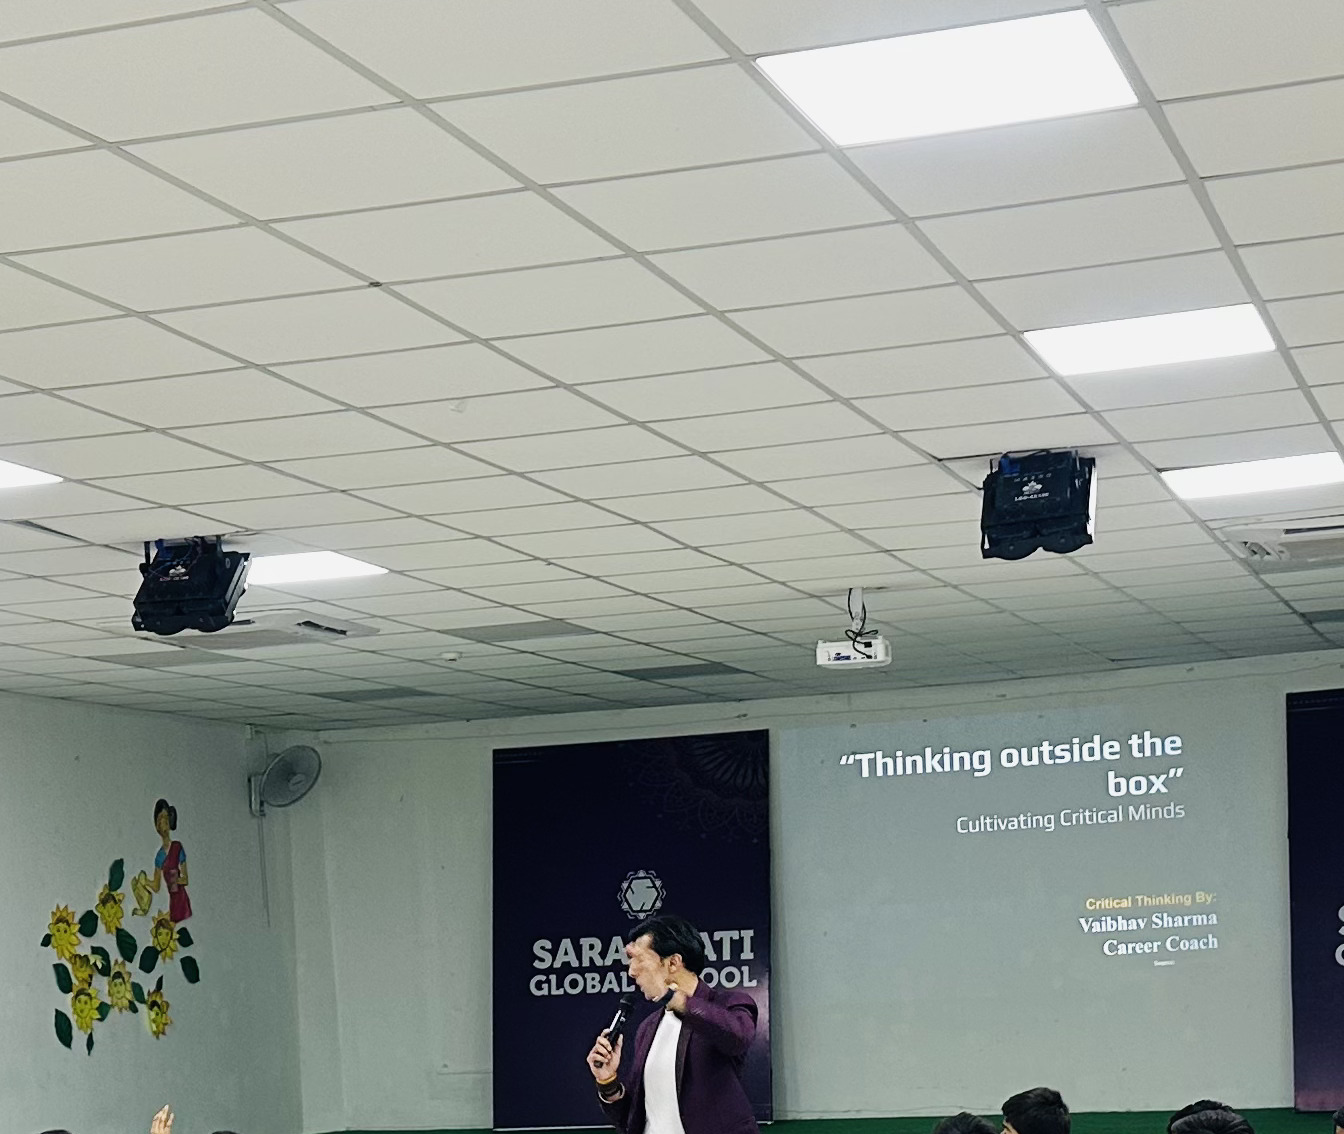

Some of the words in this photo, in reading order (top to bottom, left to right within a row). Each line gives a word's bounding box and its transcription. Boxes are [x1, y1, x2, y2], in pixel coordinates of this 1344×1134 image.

[839, 746, 991, 777] “Thinking
[1000, 735, 1120, 768] outside
[1128, 730, 1183, 758] the
[1108, 767, 1184, 798] box”
[956, 811, 1055, 834] Cultivating
[1060, 805, 1123, 827] Critical
[1128, 802, 1185, 821] Minds
[1086, 896, 1132, 910] Critical
[1135, 892, 1192, 907] Thinking
[1195, 891, 1217, 905] By:
[1079, 916, 1147, 933] Vaibhav
[1151, 912, 1218, 929] Sharma
[532, 929, 754, 969] SARAATI
[1103, 939, 1161, 956] Career
[1165, 934, 1218, 952] Coach
[529, 971, 636, 996] GLOBAL
